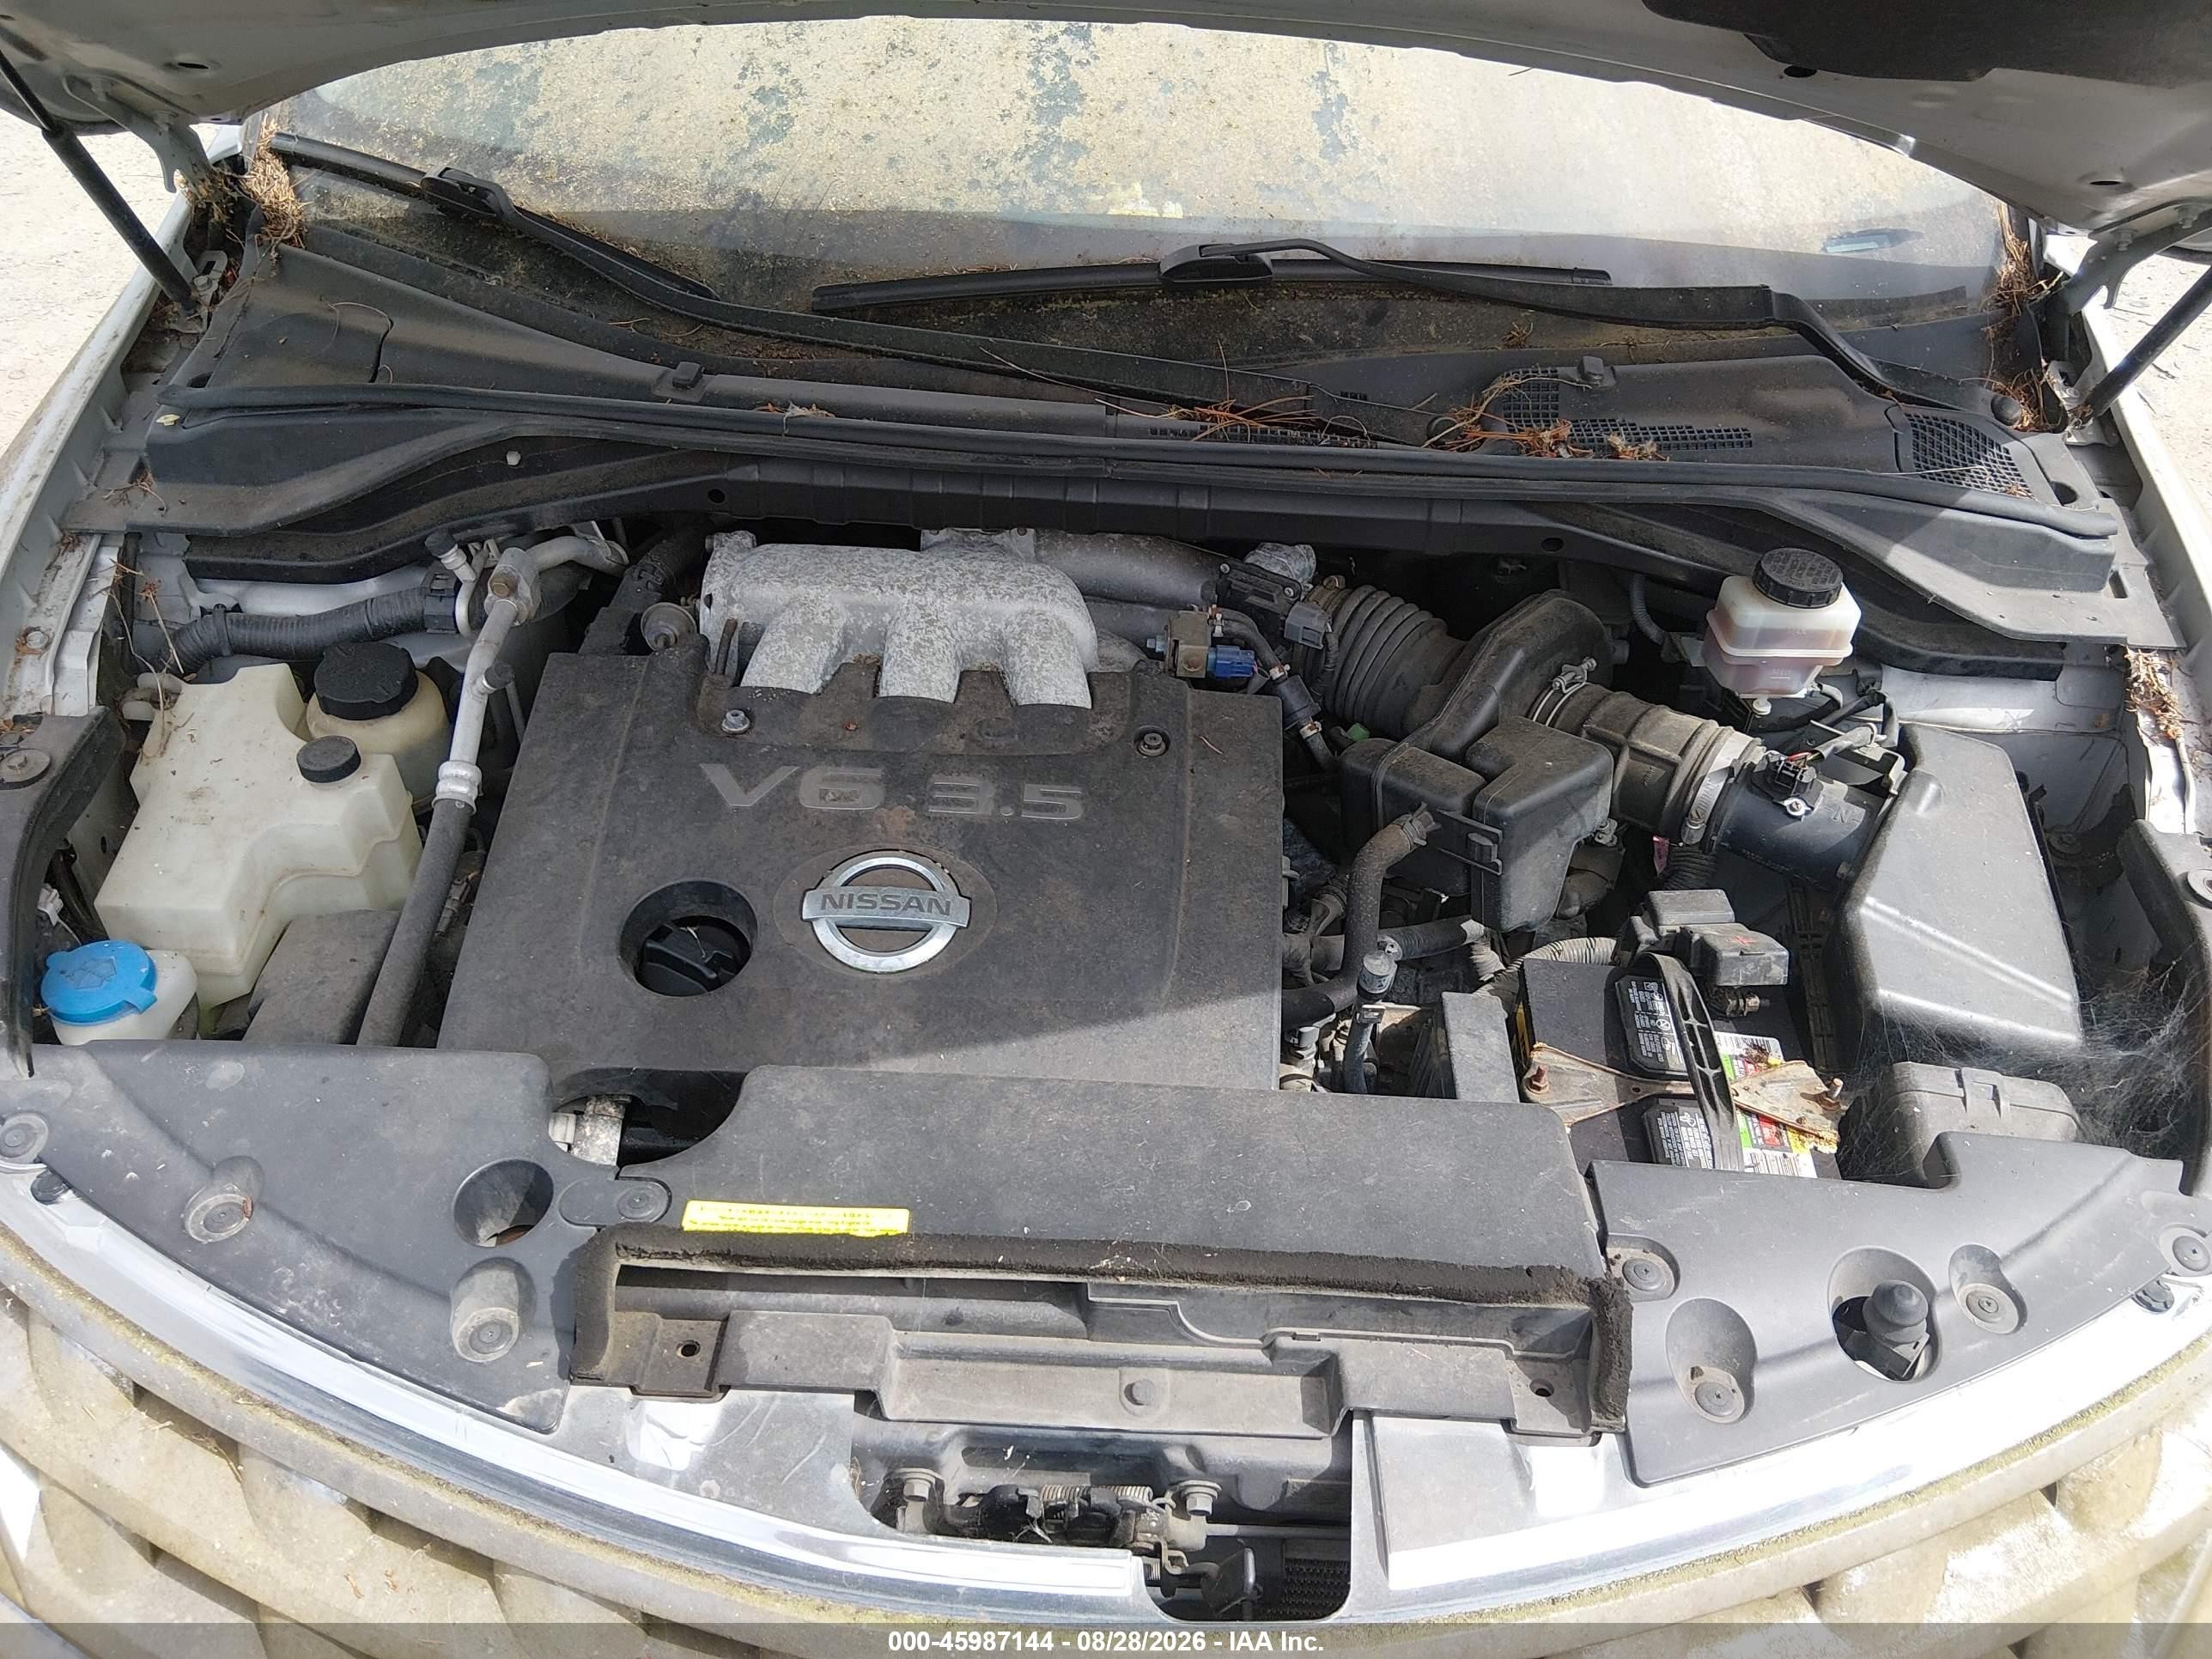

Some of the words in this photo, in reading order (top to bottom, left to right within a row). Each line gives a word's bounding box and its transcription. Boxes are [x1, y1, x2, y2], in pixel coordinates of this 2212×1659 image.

[700, 763, 885, 810] V6
[927, 773, 1085, 820] 3.5
[821, 893, 951, 916] NISSAN
